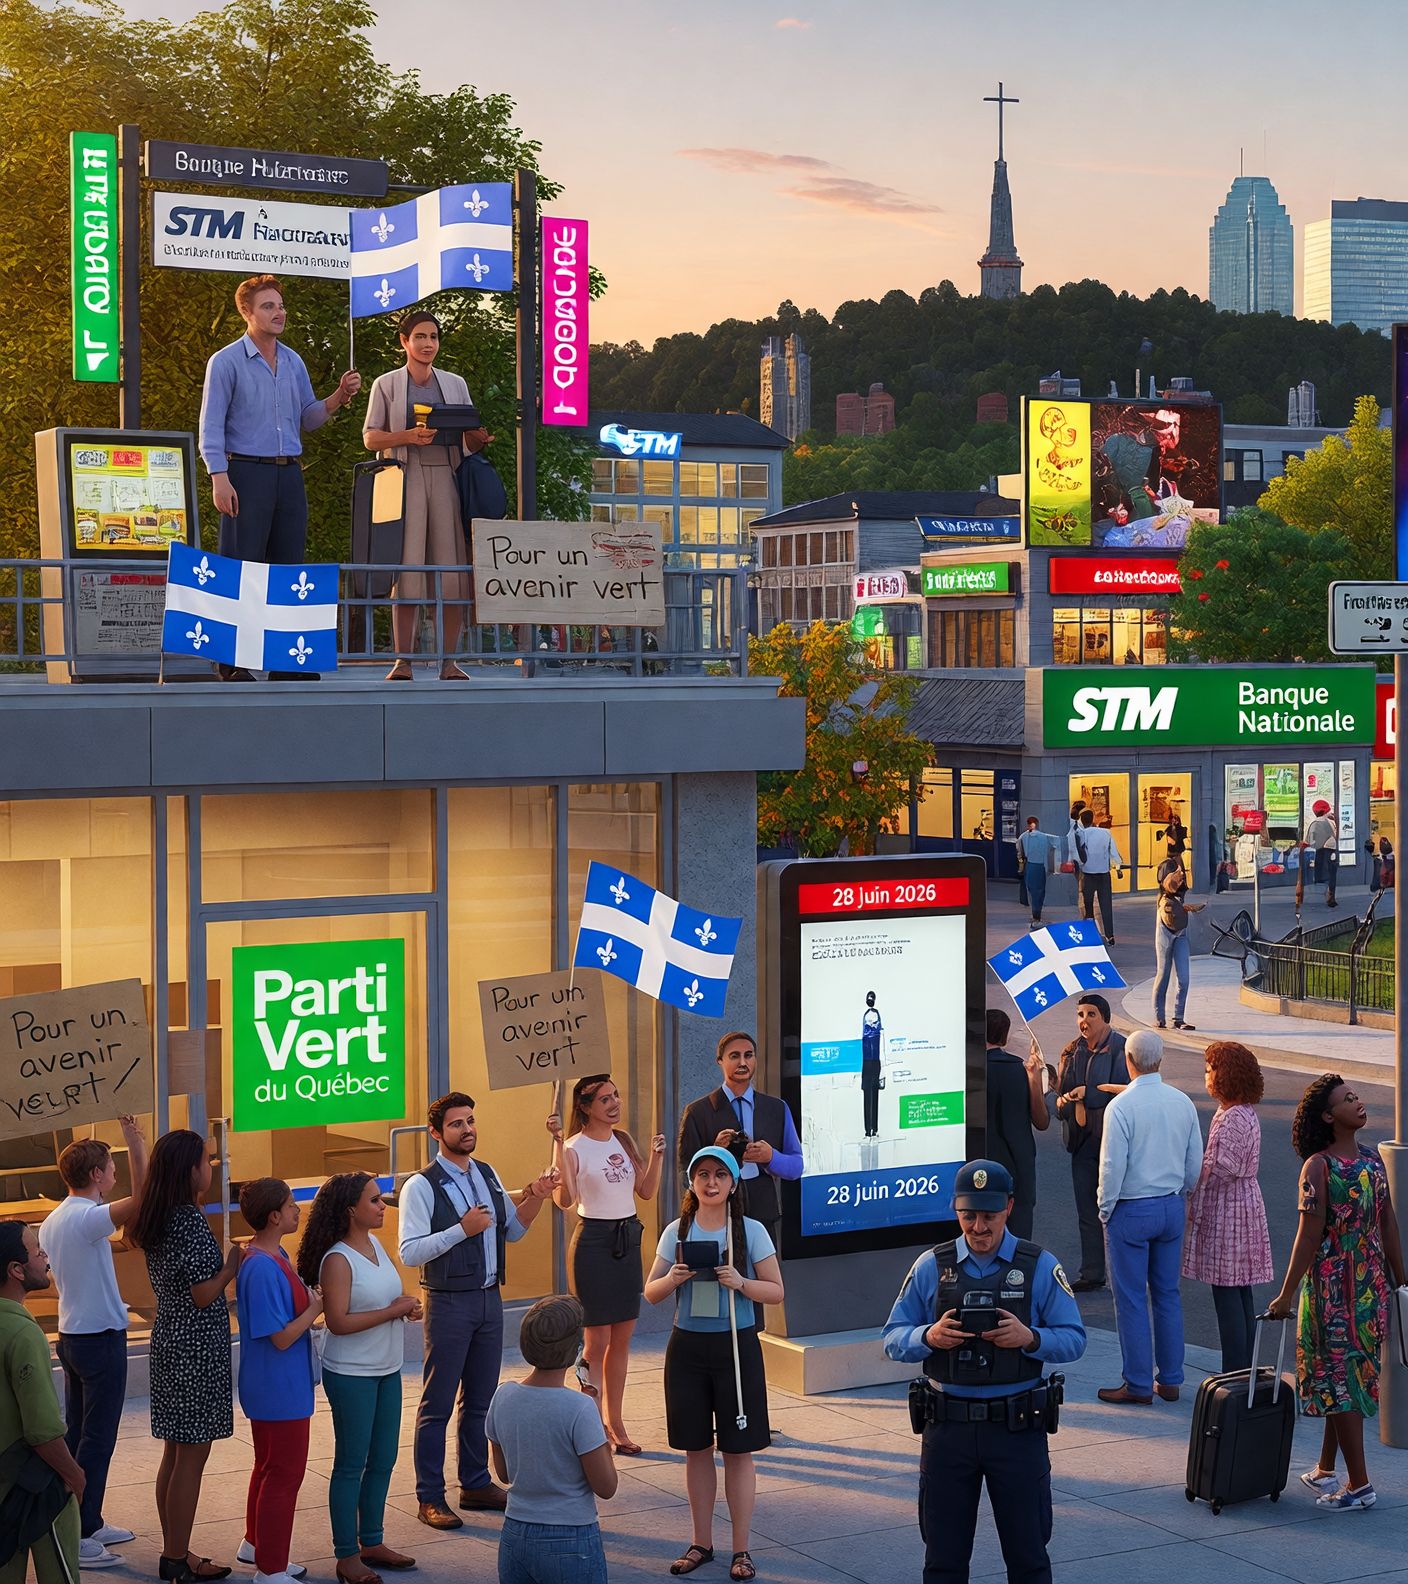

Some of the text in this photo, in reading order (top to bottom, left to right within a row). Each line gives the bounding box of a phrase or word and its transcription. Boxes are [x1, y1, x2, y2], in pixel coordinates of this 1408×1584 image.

[164, 205, 246, 240] STM
[486, 535, 588, 570] Pour un
[485, 571, 663, 600] avenir vert
[1067, 686, 1179, 732] STM
[1238, 681, 1329, 711] Banque
[1238, 709, 1356, 734] Nationale
[832, 887, 855, 907] 28
[895, 883, 937, 903] 2026
[253, 962, 388, 1020] Parti
[490, 986, 541, 1013] Pour
[10, 1010, 77, 1050] Pour
[253, 1015, 388, 1072] Vert
[20, 1038, 122, 1079] avenir
[515, 1035, 581, 1072] vert
[254, 1071, 390, 1103] du Québec
[827, 1175, 940, 1207] 28 juin 2026
